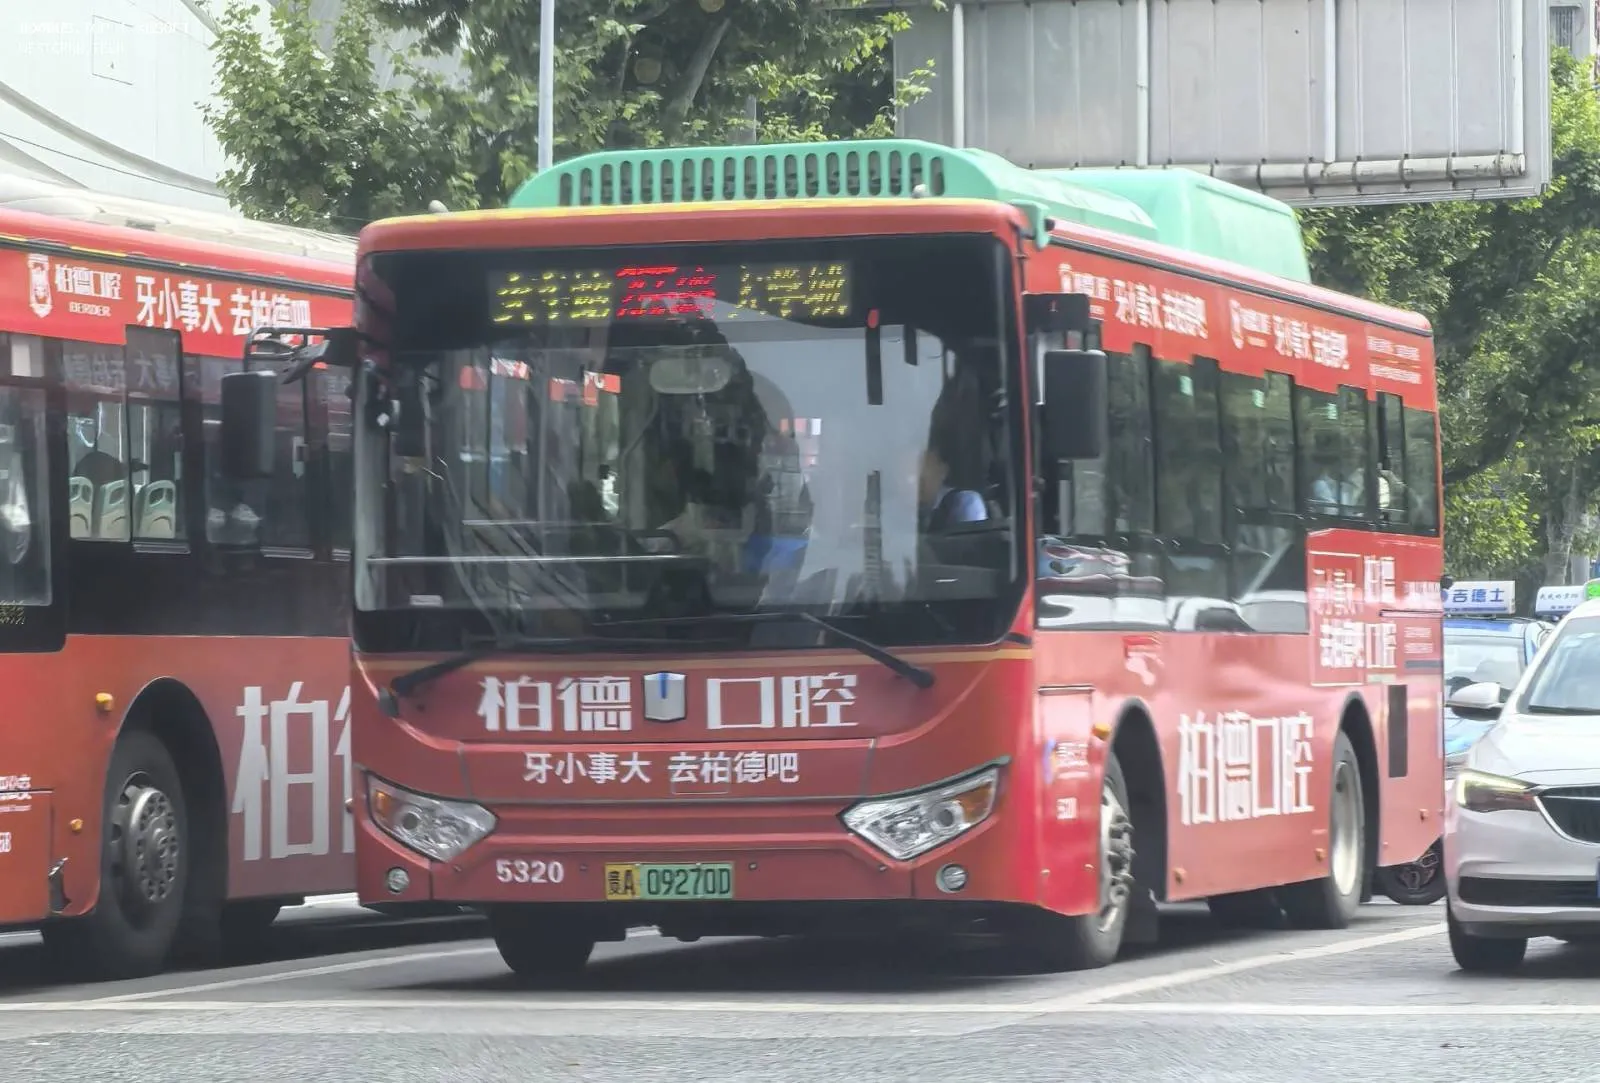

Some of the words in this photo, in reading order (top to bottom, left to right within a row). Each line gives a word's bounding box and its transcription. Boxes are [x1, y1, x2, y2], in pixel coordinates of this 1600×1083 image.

[135, 275, 223, 335] 牙小事大
[477, 675, 633, 732] 柏德
[706, 672, 858, 730] 口腔
[523, 751, 652, 785] 牙小事大
[667, 751, 800, 784] 去柏德吧
[1177, 710, 1315, 826] 柏德口腔
[496, 860, 565, 884] 5320
